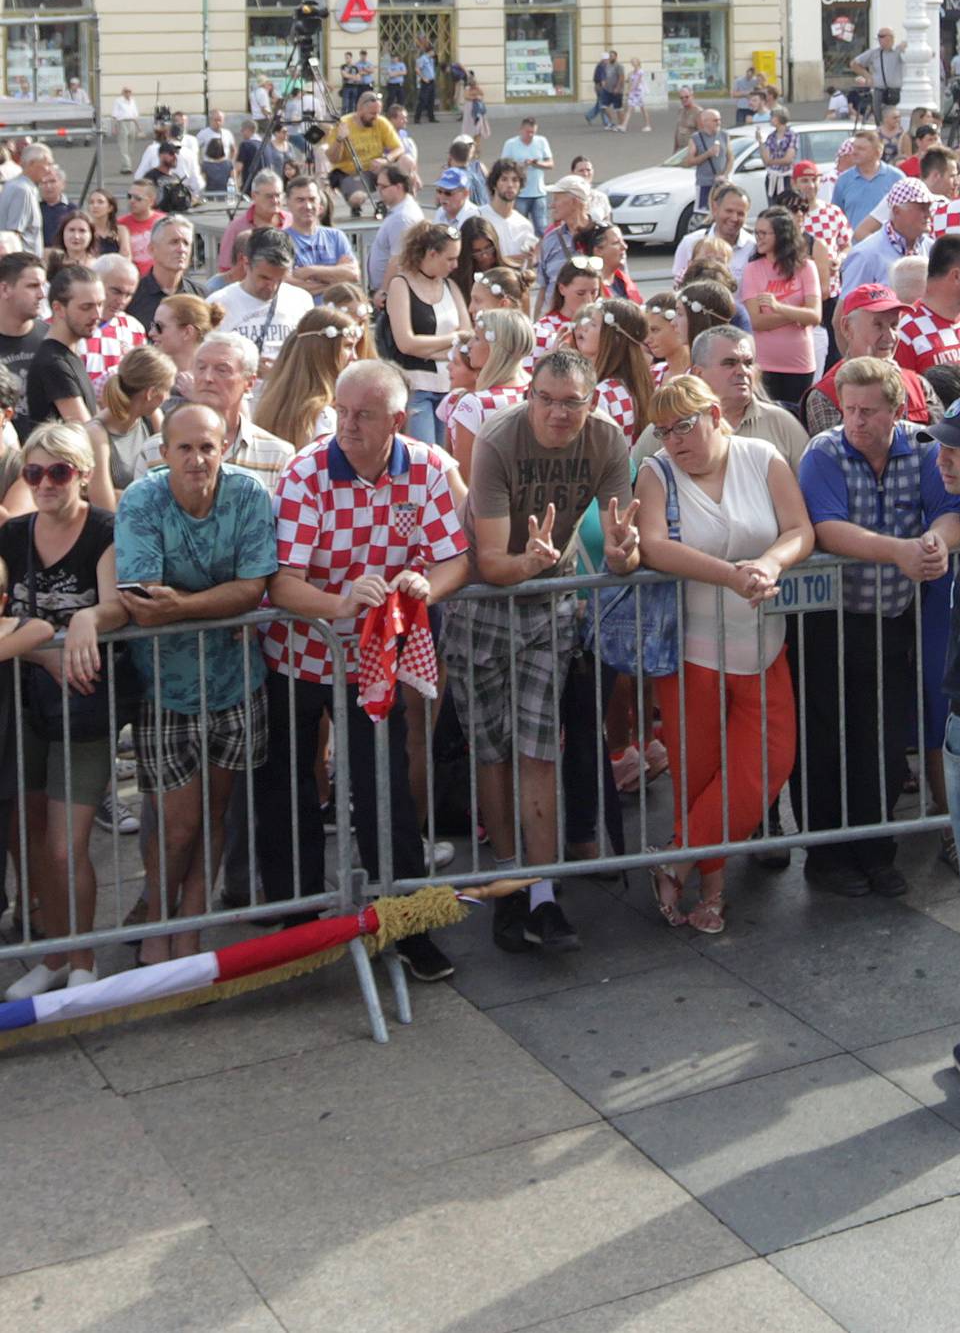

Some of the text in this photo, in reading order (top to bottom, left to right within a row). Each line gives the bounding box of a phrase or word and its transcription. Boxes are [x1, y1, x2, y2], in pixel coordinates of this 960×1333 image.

[518, 458, 592, 485] HAVANA
[518, 485, 592, 512] 1962
[774, 573, 832, 607] TOI TOI
